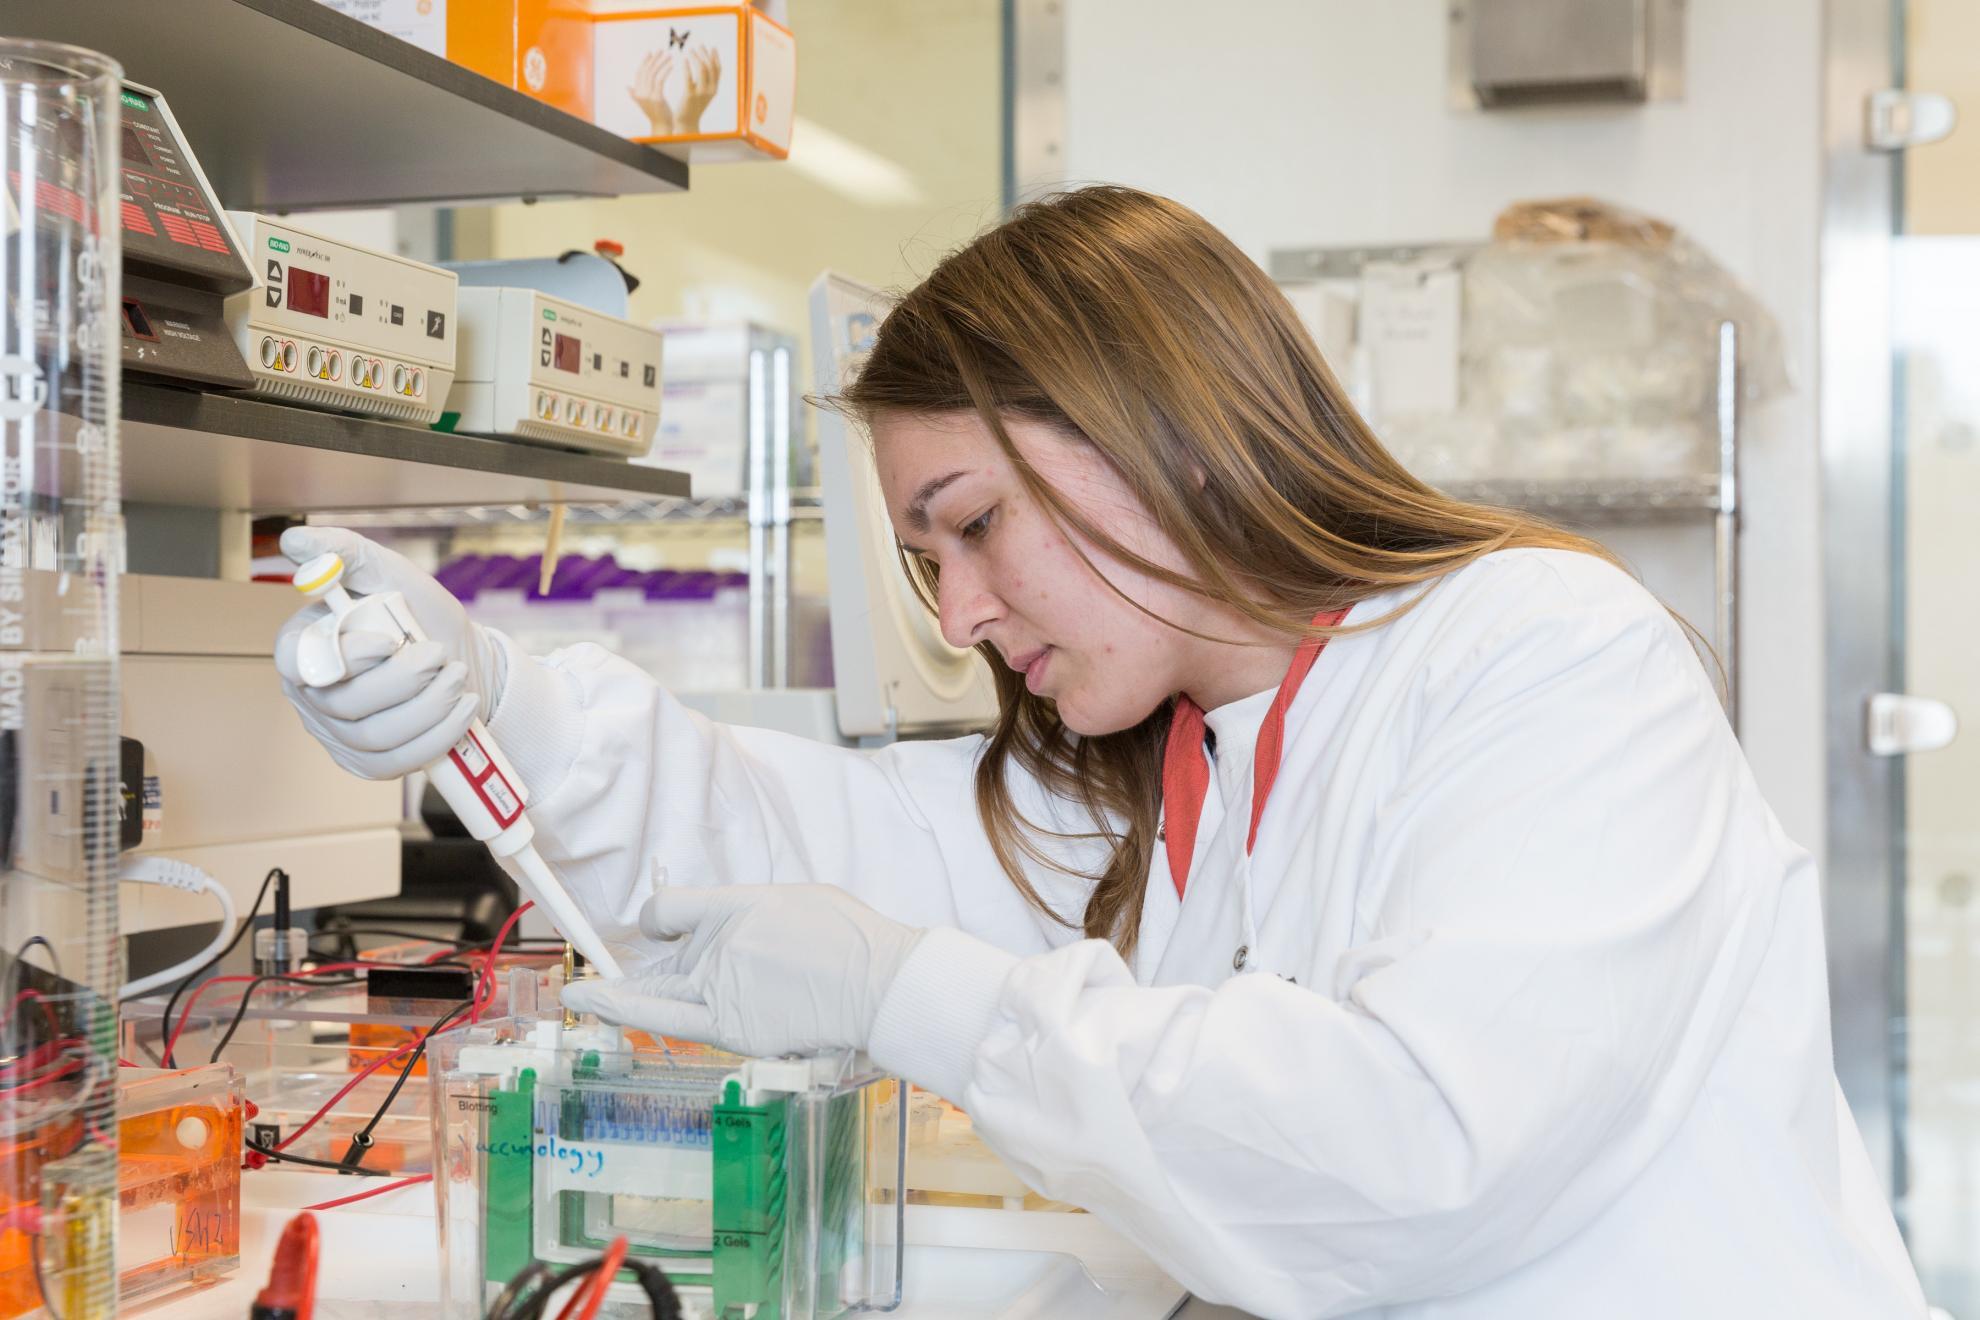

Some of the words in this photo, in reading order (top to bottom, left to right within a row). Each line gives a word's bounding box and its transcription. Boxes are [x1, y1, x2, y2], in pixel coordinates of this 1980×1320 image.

[268, 238, 290, 252] BIO-RAD
[1, 609, 24, 645] BY
[458, 1100, 498, 1115] Blotting
[725, 1116, 752, 1128] Gels
[723, 1236, 751, 1248] Gels
